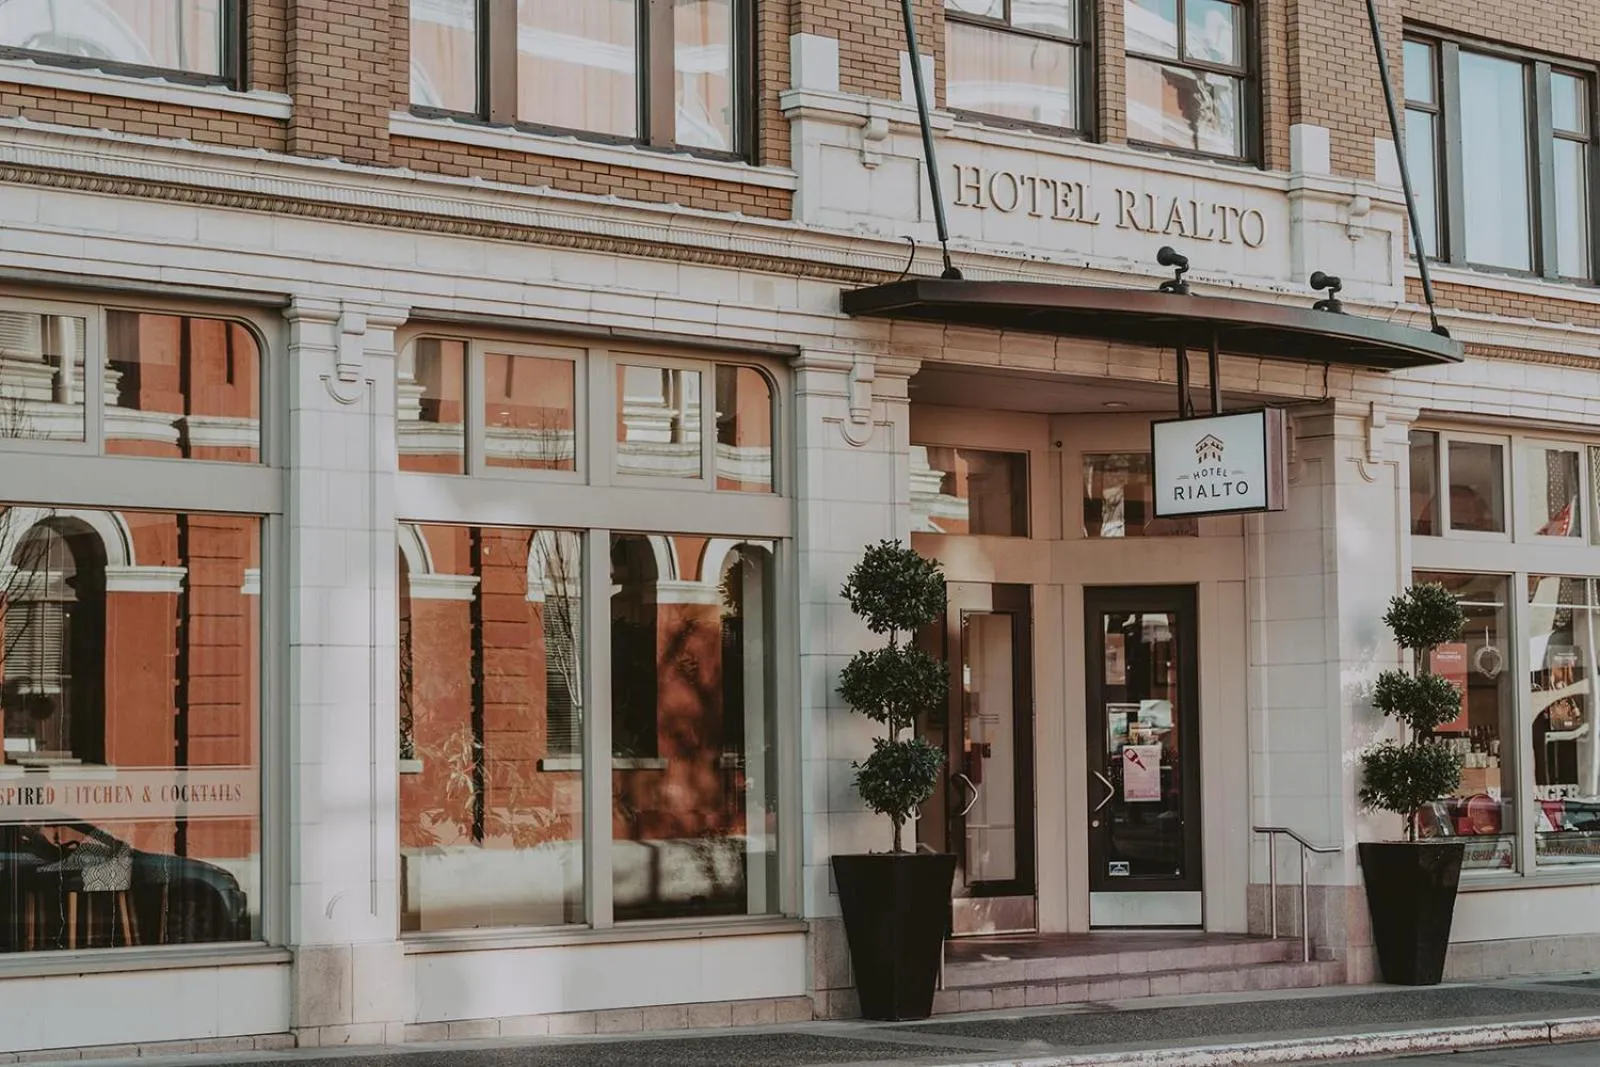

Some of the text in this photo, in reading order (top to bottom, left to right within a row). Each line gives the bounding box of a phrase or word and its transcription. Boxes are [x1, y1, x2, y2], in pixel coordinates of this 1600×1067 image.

[953, 163, 1267, 249] HOTEL RIALTO
[1192, 467, 1228, 480] HOTEL
[1173, 480, 1249, 501] RIALTO
[142, 784, 152, 803] &
[161, 783, 242, 802] COCKTAILS
